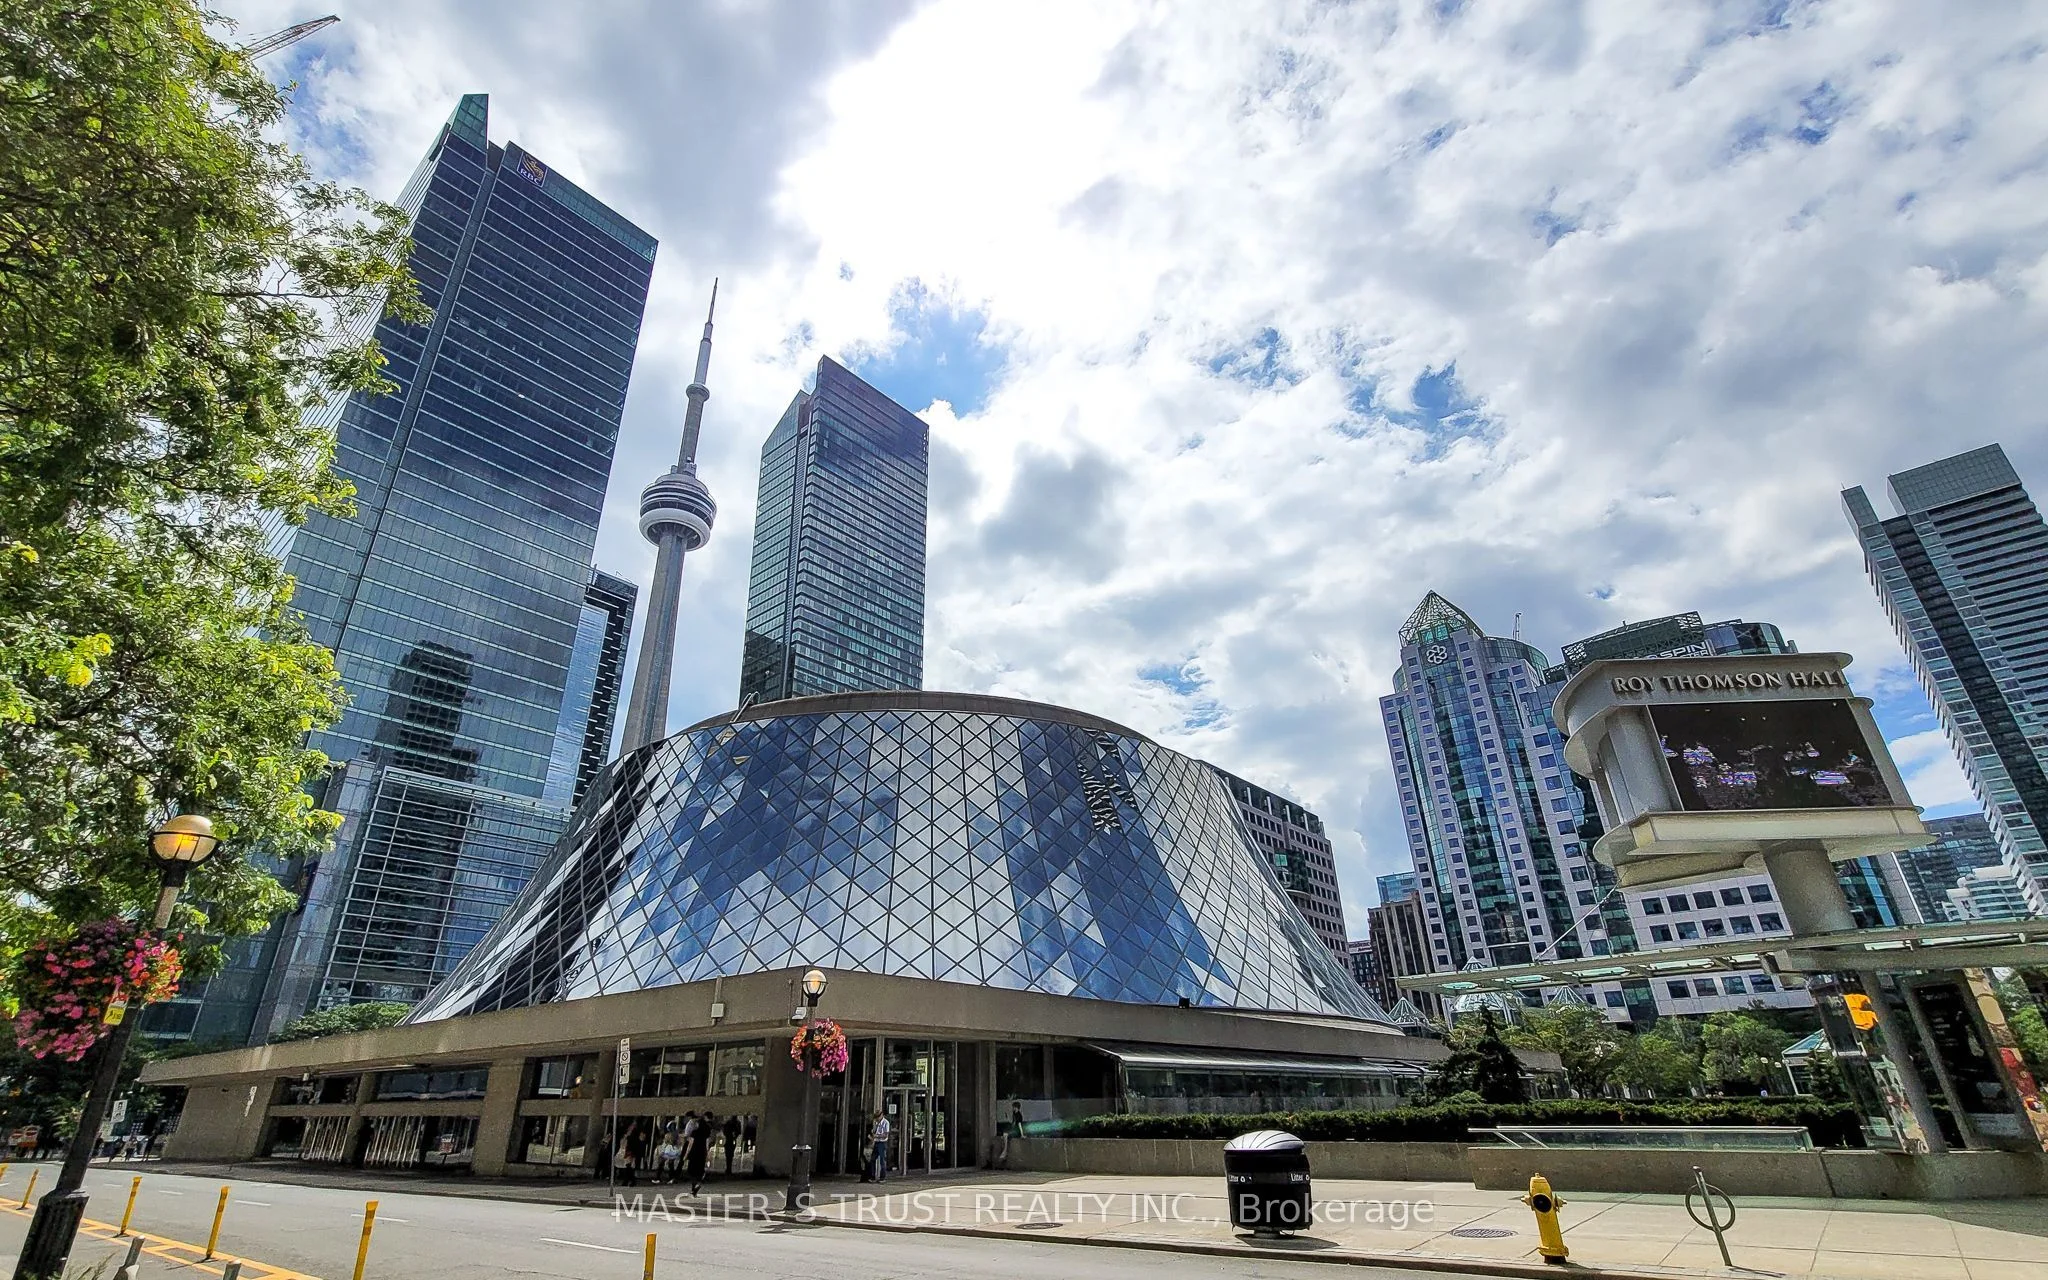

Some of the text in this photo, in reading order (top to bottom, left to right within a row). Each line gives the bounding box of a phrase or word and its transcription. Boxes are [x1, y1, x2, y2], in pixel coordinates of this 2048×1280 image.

[520, 168, 541, 185] RBC
[1660, 641, 1707, 657] SPIN
[1614, 676, 1655, 692] ROY
[1662, 672, 1782, 690] THOMSON
